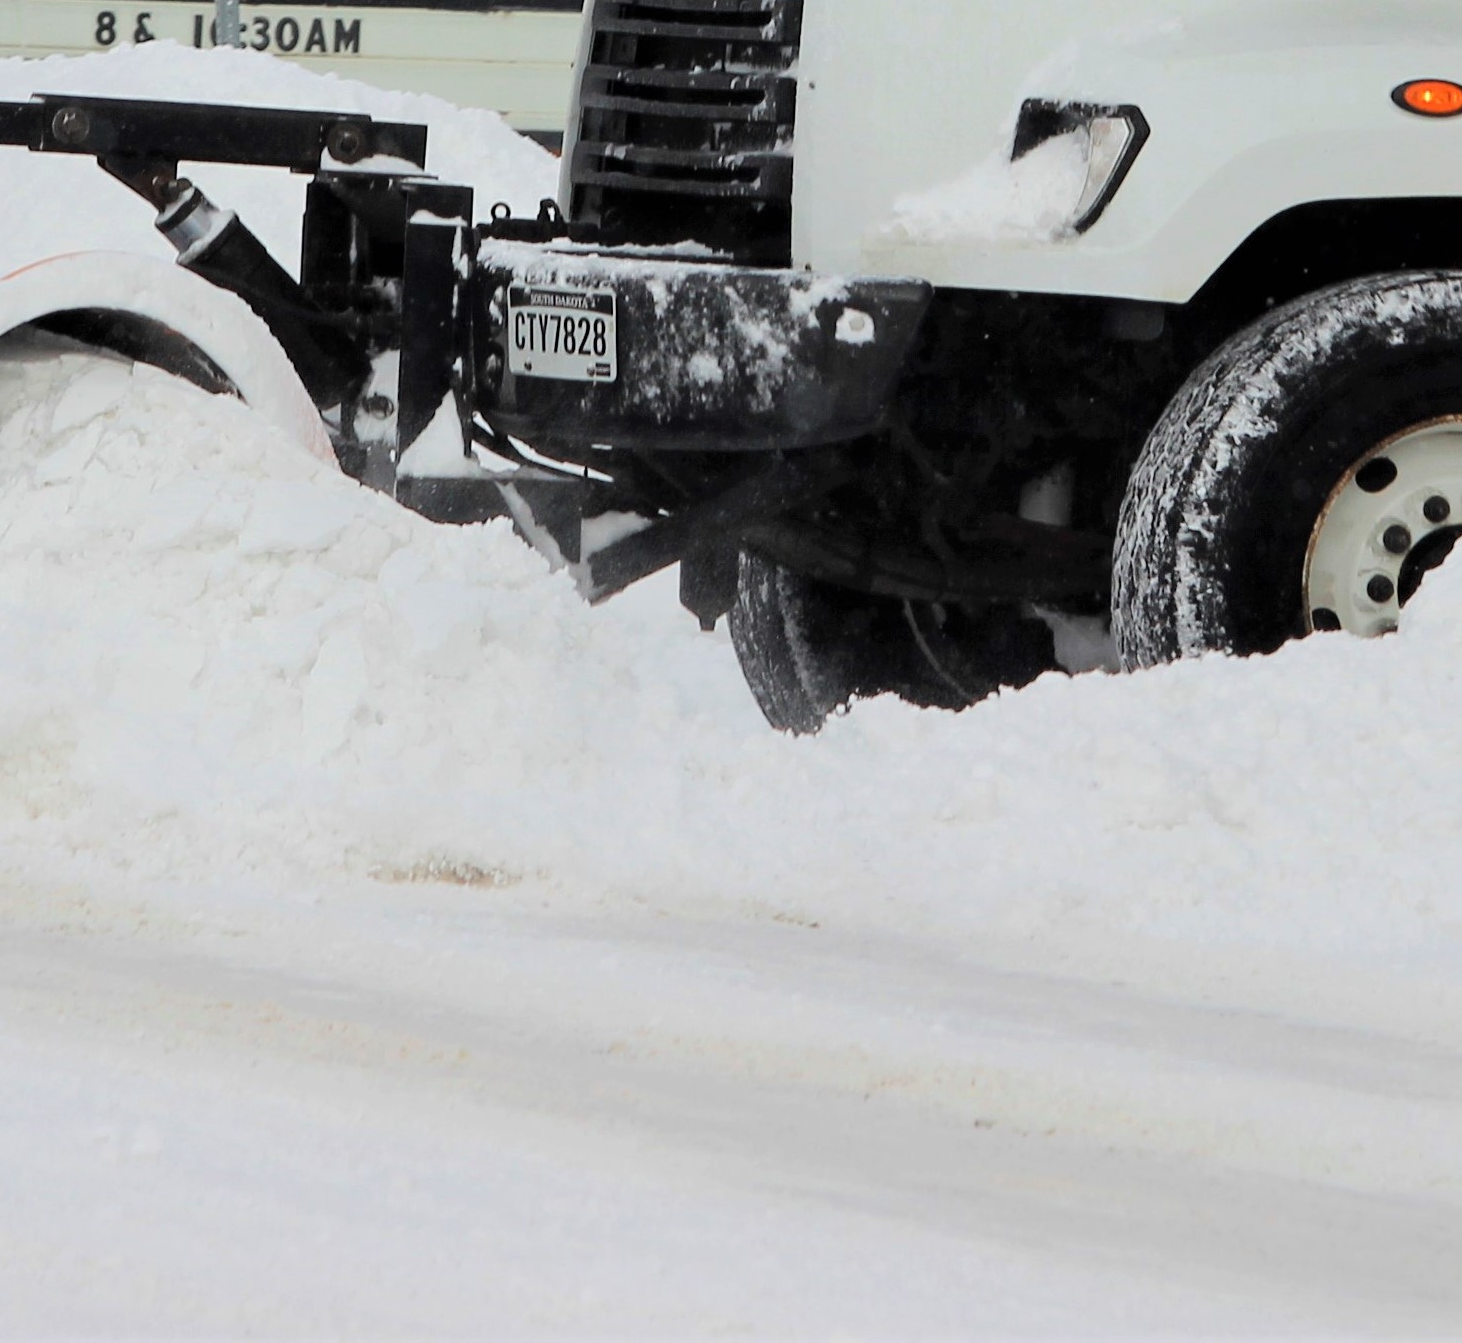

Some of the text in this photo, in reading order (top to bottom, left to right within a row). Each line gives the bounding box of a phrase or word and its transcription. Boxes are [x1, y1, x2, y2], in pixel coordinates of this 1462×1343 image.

[95, 11, 116, 45] 8
[133, 12, 156, 43] &
[531, 293, 589, 309] SOUTH DAKOTA
[515, 311, 607, 356] CTY7828
